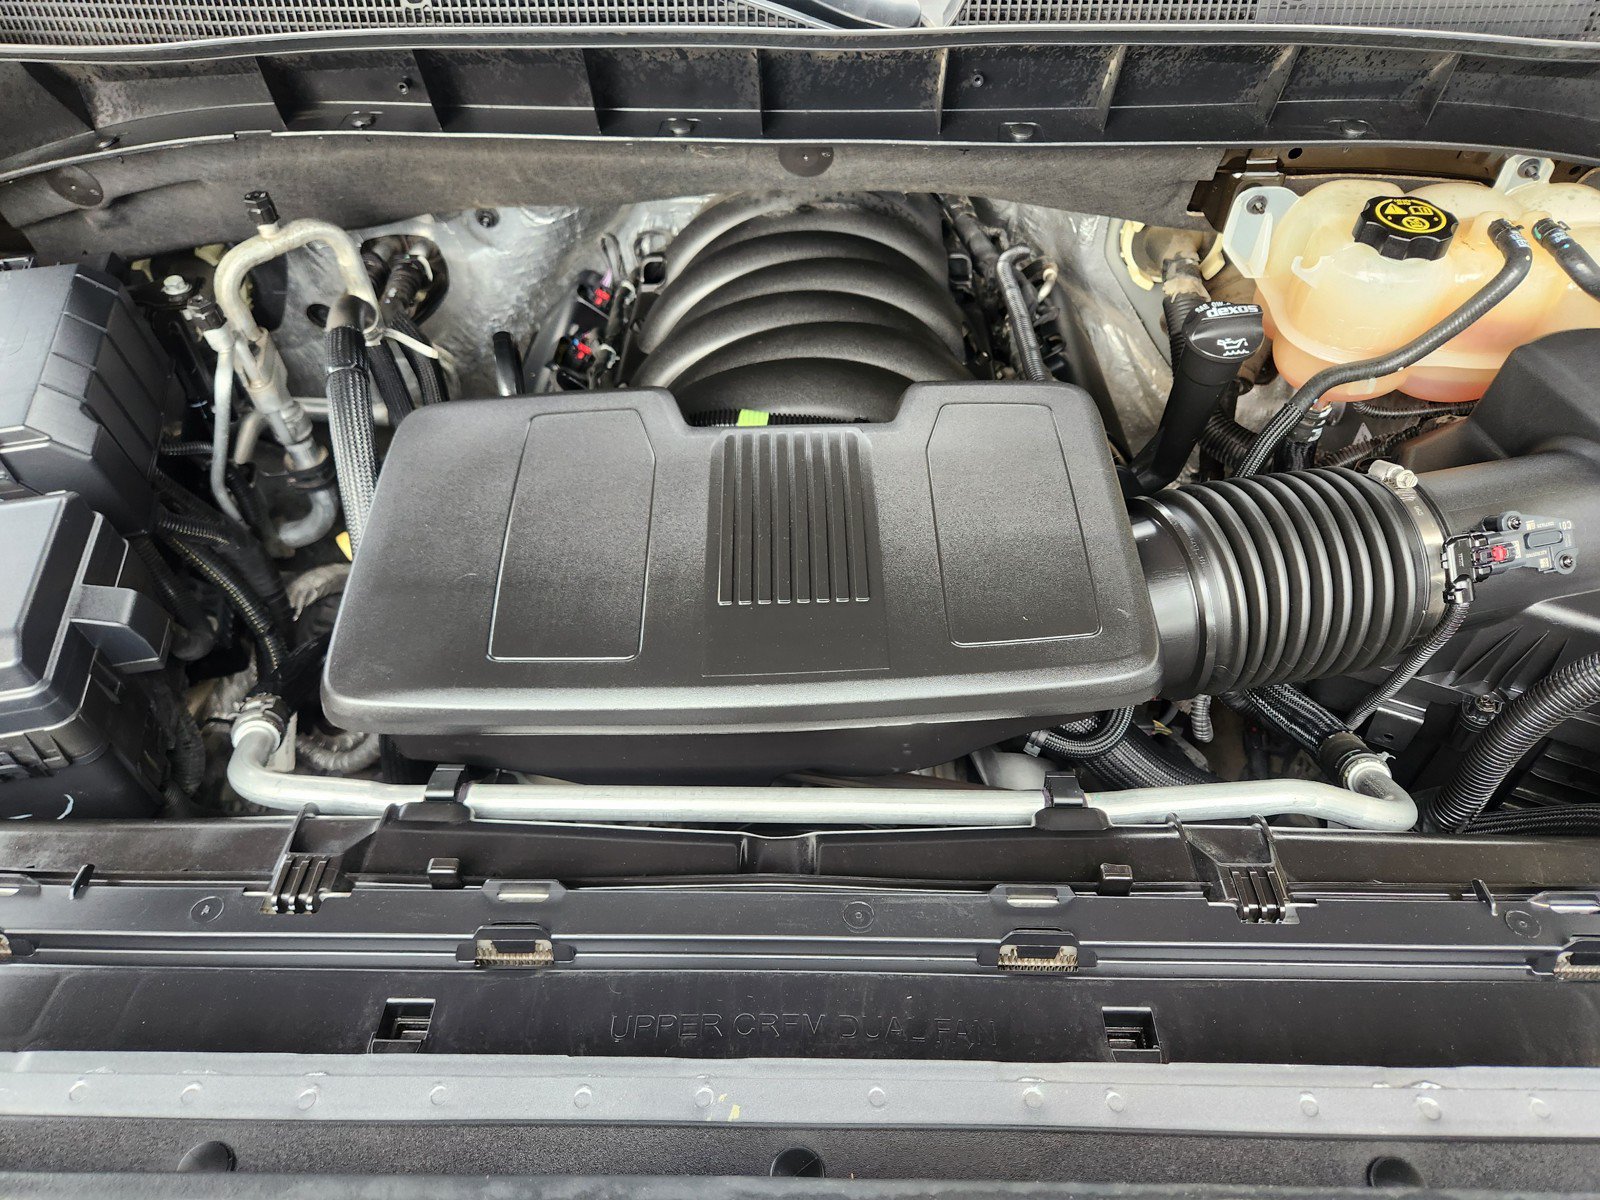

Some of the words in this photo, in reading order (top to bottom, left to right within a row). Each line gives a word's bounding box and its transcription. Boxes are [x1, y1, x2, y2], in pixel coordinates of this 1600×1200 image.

[1206, 305, 1258, 317] dexos
[610, 1013, 723, 1040] UPPER
[838, 1013, 926, 1042] DUAL
[934, 1017, 997, 1047] FAN
